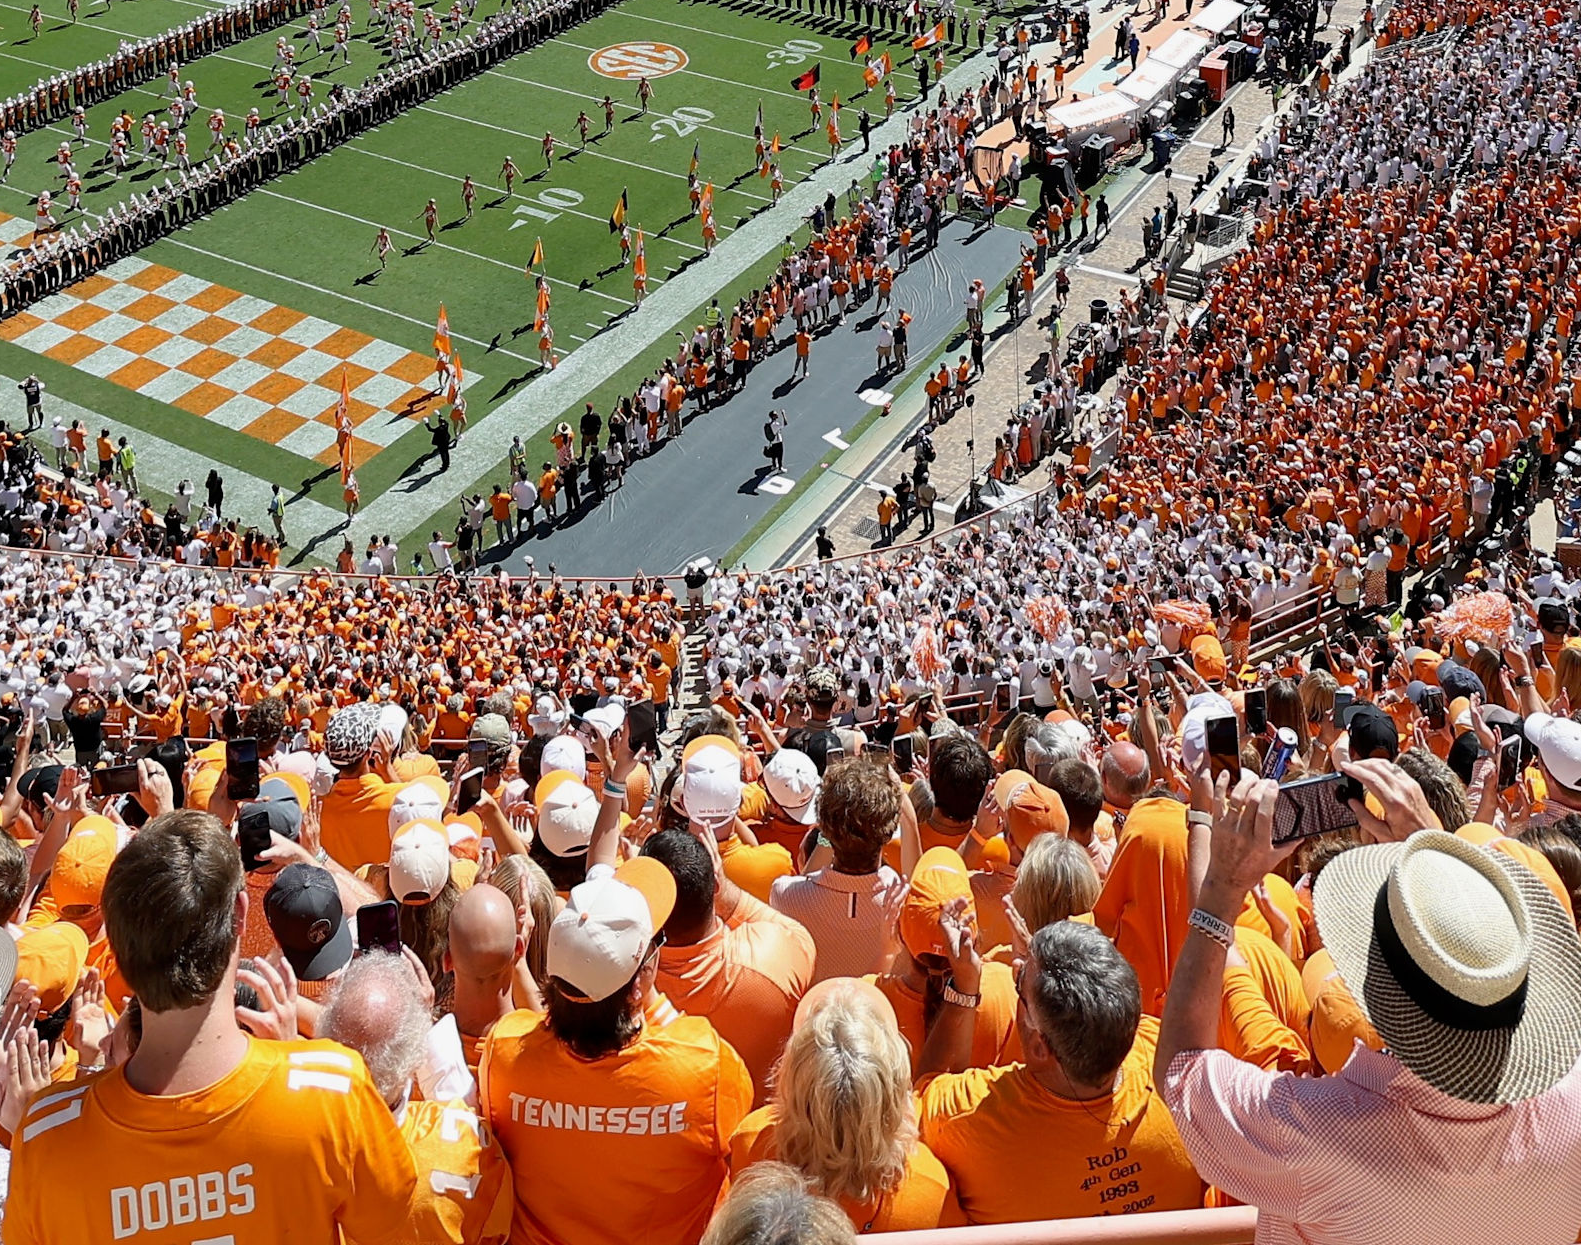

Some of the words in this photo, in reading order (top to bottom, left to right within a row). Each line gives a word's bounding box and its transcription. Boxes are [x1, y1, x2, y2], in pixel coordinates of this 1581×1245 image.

[596, 43, 685, 78] SEC
[767, 39, 824, 64] 30
[651, 106, 715, 138] 20
[512, 188, 586, 224] 10
[107, 712, 121, 722] 24
[1192, 910, 1230, 937] TERRACE
[286, 1051, 352, 1094] 11
[508, 1092, 688, 1134] TENNESSEE
[1086, 1146, 1128, 1170] Rob
[1080, 1176, 1101, 1191] 4th
[1109, 1160, 1142, 1180] Gen
[110, 1163, 256, 1240] DOBBS
[1100, 1180, 1139, 1204] 1993
[1122, 1196, 1155, 1214] 2002
